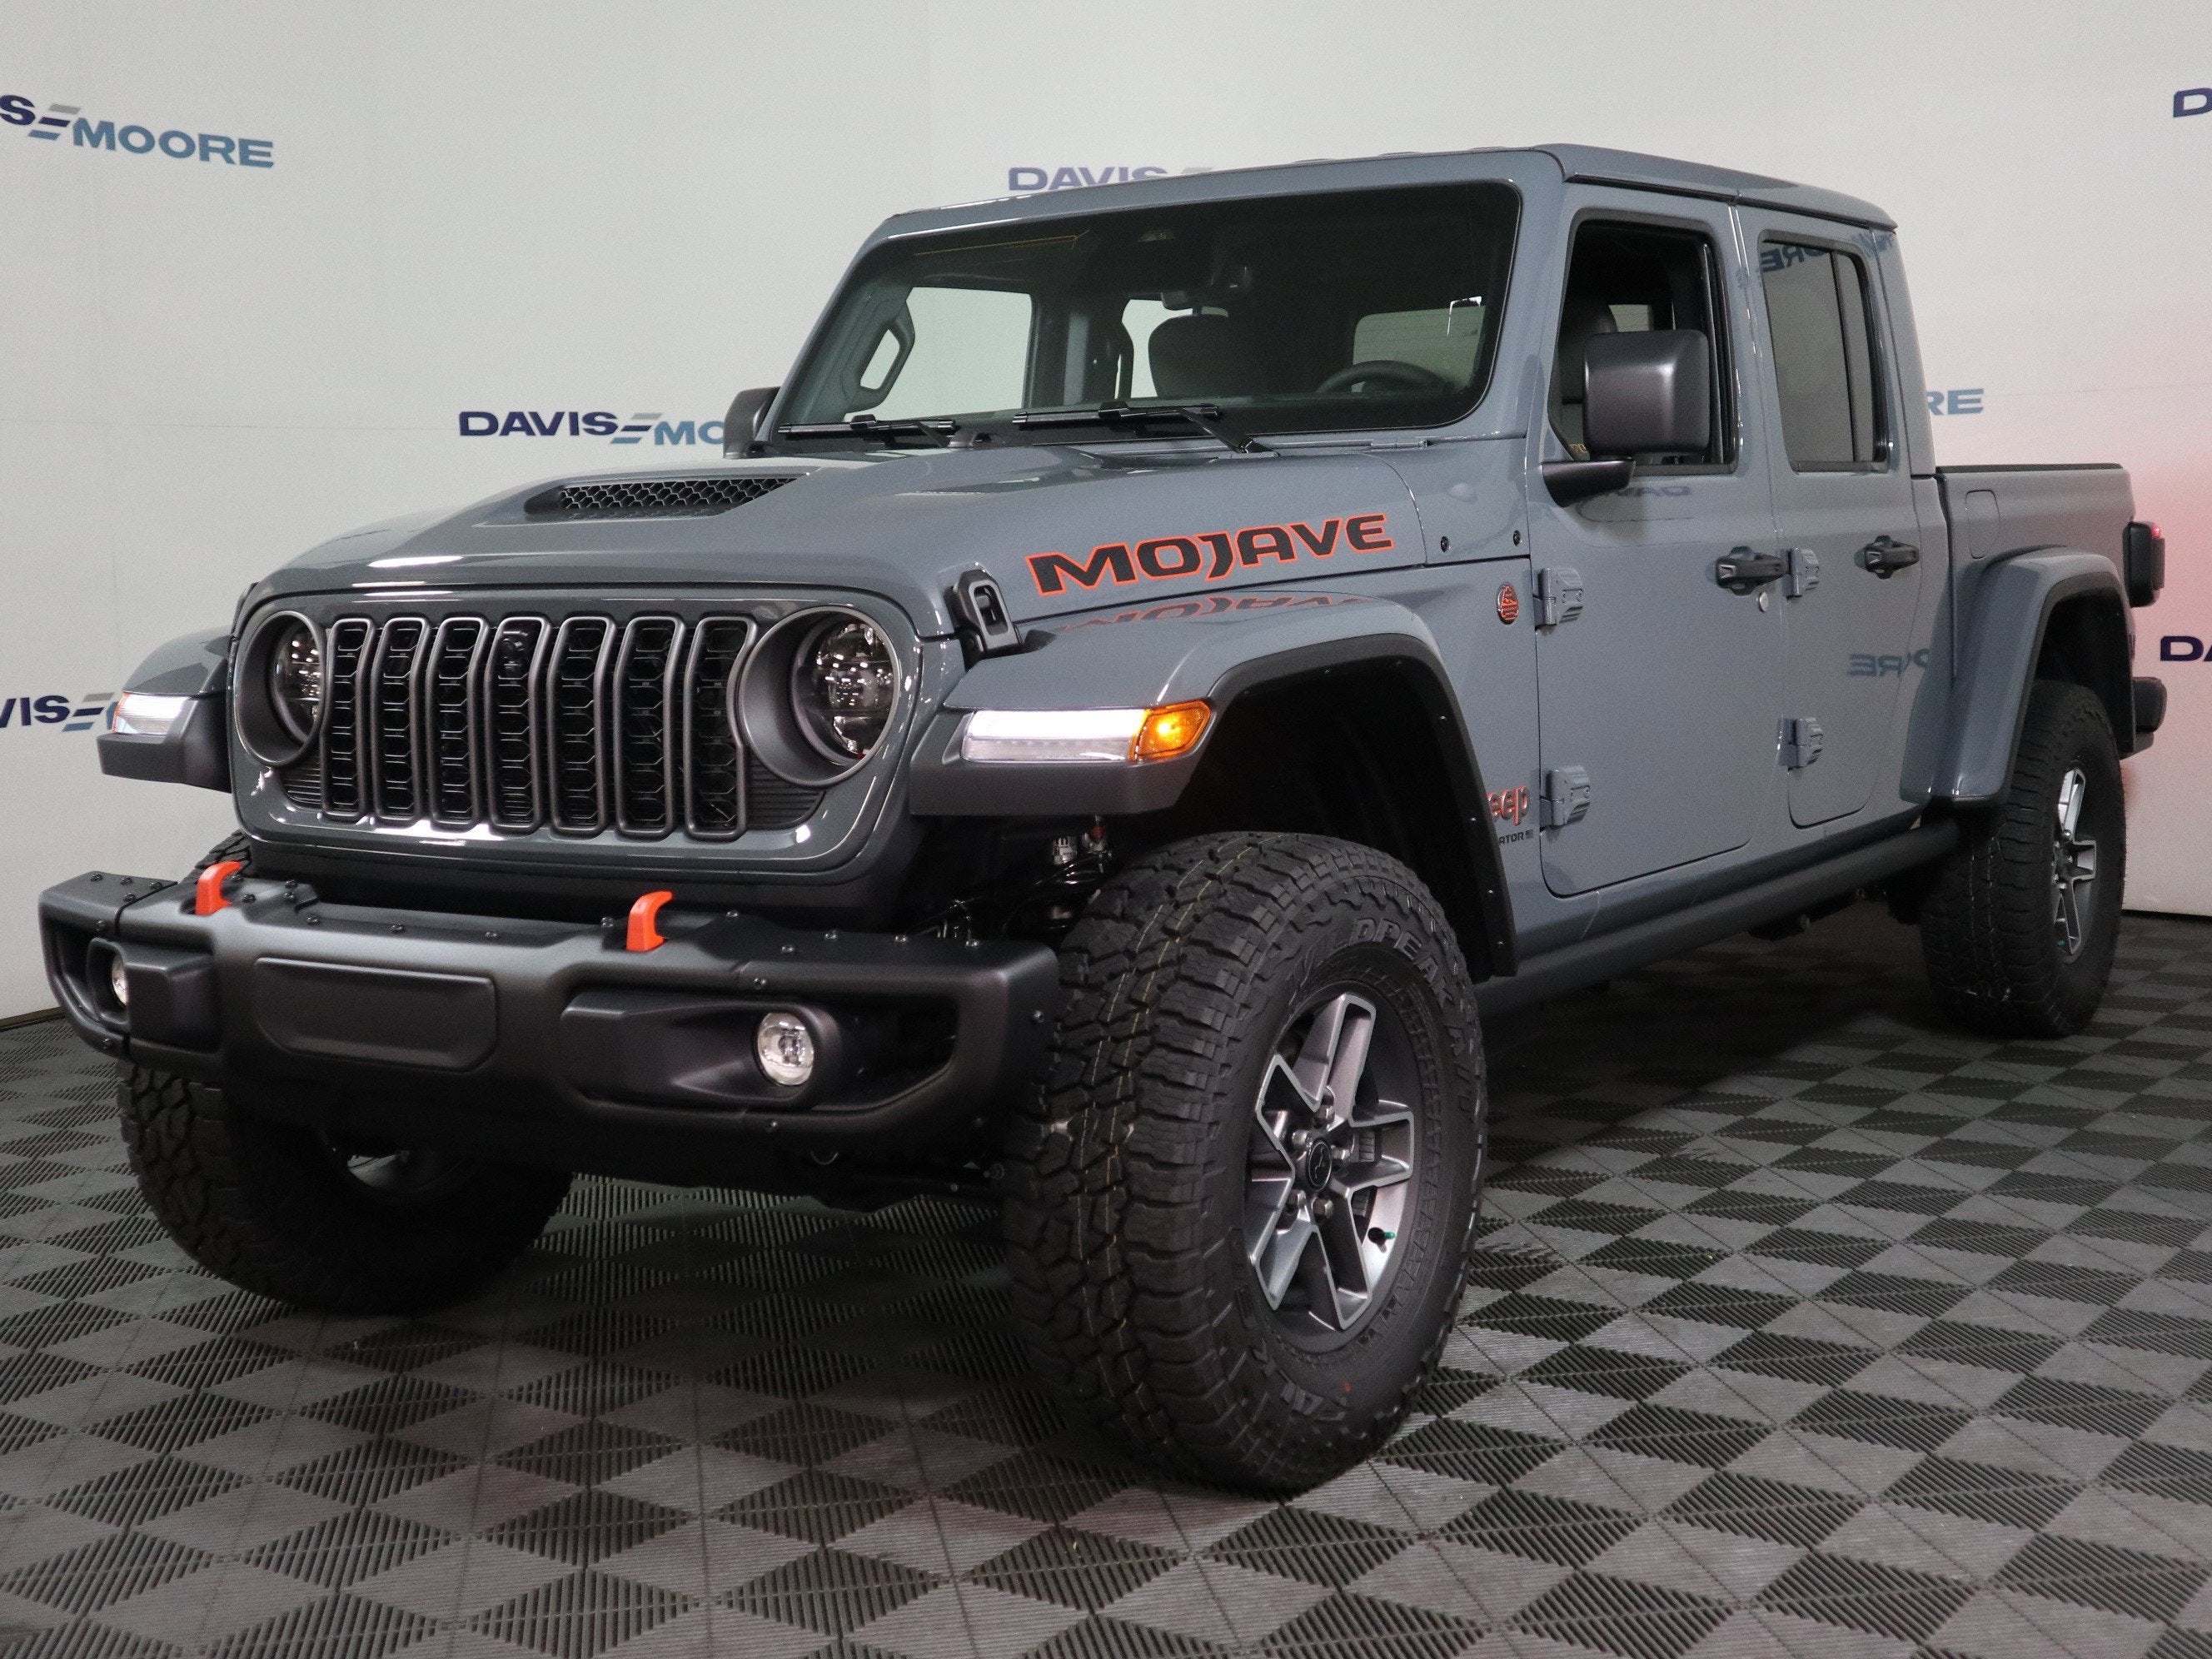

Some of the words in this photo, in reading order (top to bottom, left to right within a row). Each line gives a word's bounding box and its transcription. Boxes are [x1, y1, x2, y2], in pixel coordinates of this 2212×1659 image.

[72, 117, 275, 168] MOORE
[458, 411, 619, 436] DAVIS
[1025, 513, 1395, 597] MOJAVE
[2160, 635, 2212, 662] D
